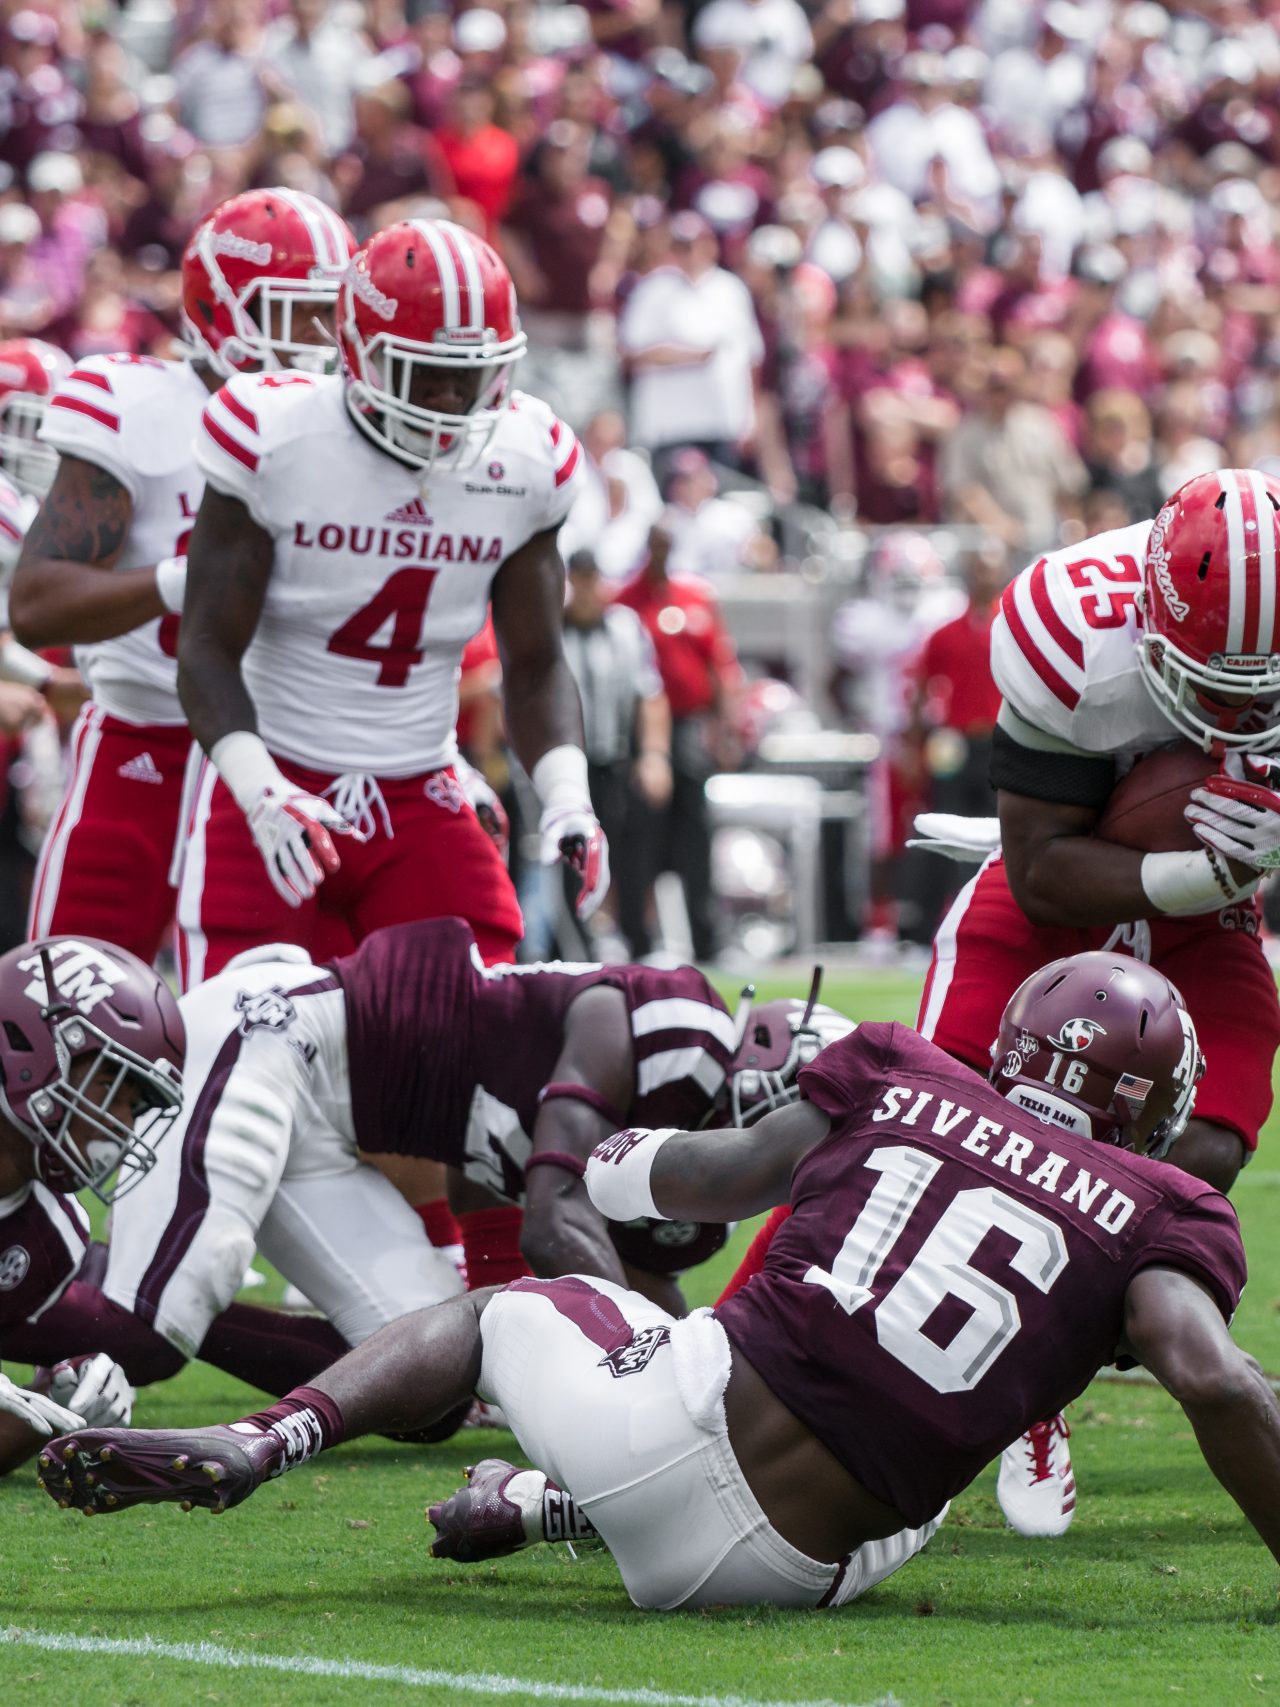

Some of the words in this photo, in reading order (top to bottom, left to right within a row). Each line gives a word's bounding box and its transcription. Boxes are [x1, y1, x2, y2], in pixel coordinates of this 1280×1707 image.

[293, 520, 504, 563] LOUISIANA
[1064, 554, 1144, 630] 25
[326, 564, 441, 688] 4
[1225, 657, 1268, 668] CAJUNS
[1044, 1051, 1089, 1095] 16
[1018, 1094, 1052, 1117] TEXAS
[1052, 1109, 1078, 1128] A&M
[872, 1085, 1137, 1235] SIVERANO
[802, 1145, 1071, 1395] 16
[543, 1487, 601, 1541] GIE
